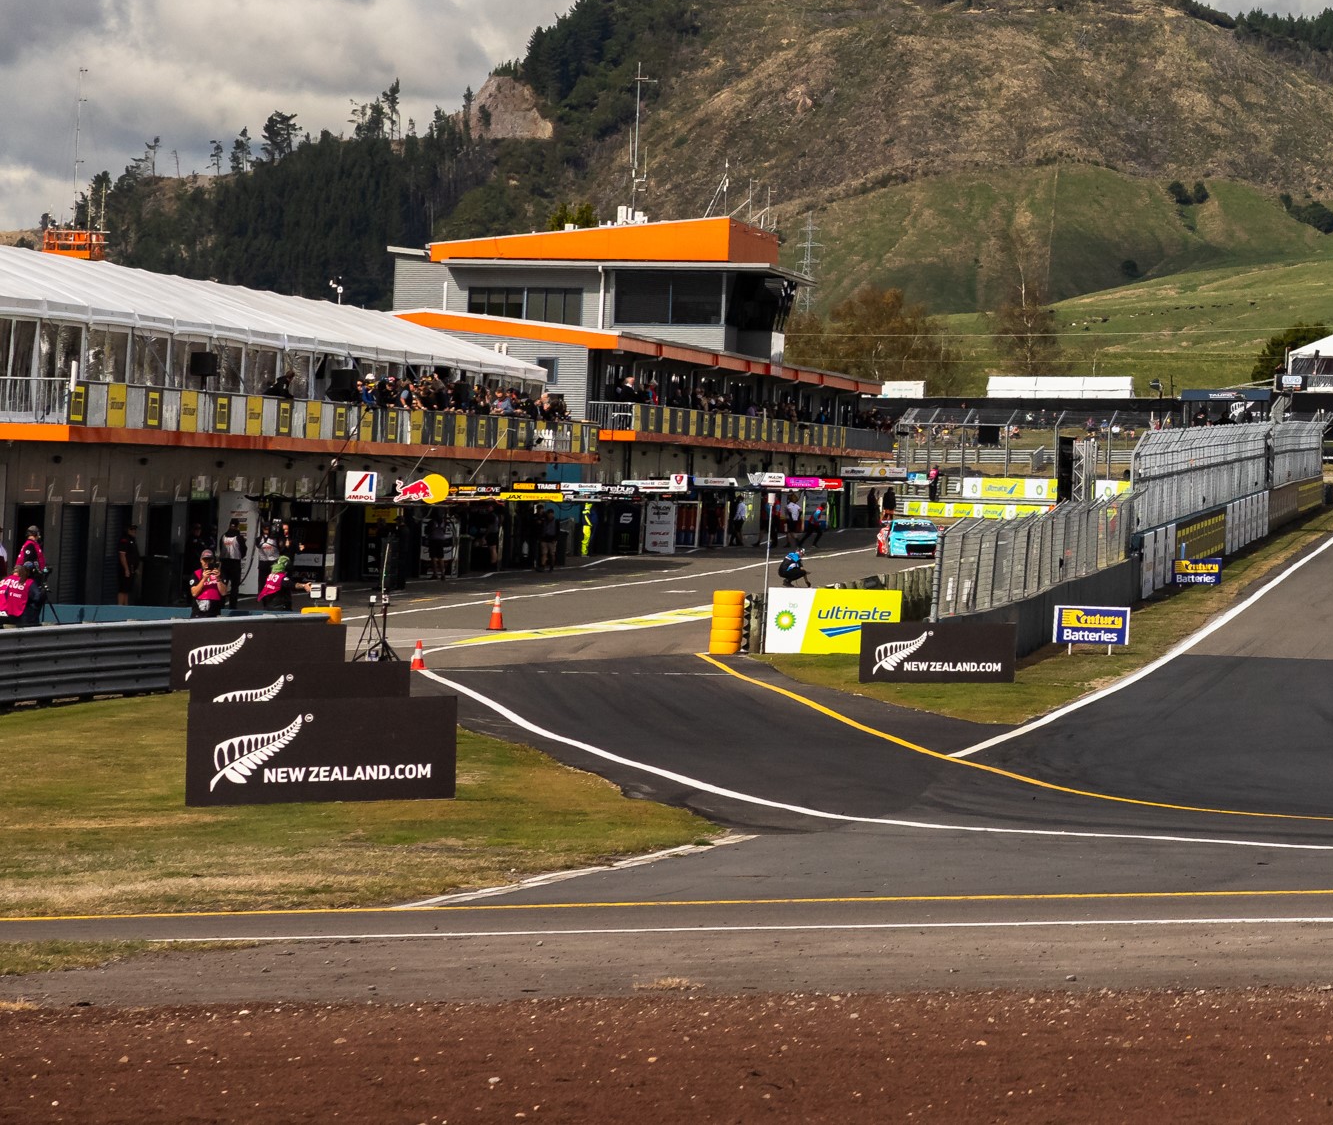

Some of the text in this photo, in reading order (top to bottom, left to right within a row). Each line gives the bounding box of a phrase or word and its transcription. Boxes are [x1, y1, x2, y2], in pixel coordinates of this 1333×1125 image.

[1176, 574, 1215, 583] Batteries
[817, 606, 892, 621] ultimate
[1072, 609, 1123, 627] Century
[1063, 629, 1118, 642] Batteries
[904, 661, 1002, 672] NEW ZEALAND.COM
[263, 763, 432, 784] NEW ZEALAND.COM
